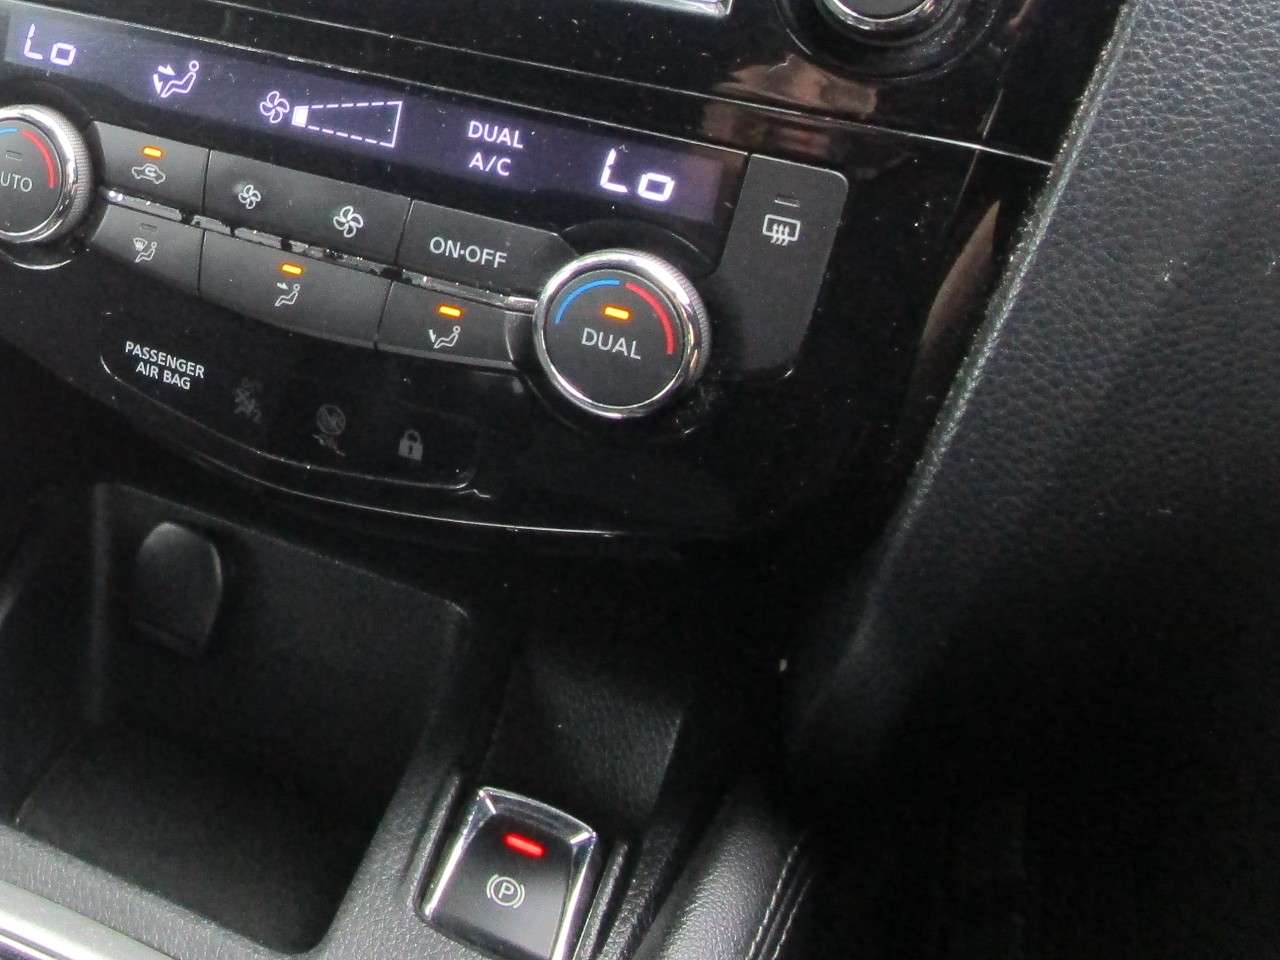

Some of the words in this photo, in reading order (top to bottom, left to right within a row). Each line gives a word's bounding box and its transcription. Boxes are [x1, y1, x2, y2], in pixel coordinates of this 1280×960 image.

[24, 23, 77, 67] Lo
[467, 120, 525, 149] DUAL
[468, 150, 512, 178] A/C
[600, 148, 675, 202] Lo
[124, 340, 206, 379] PASSENGER
[580, 327, 643, 361] DUAL
[135, 361, 160, 381] AIR
[163, 369, 191, 391] BAG
